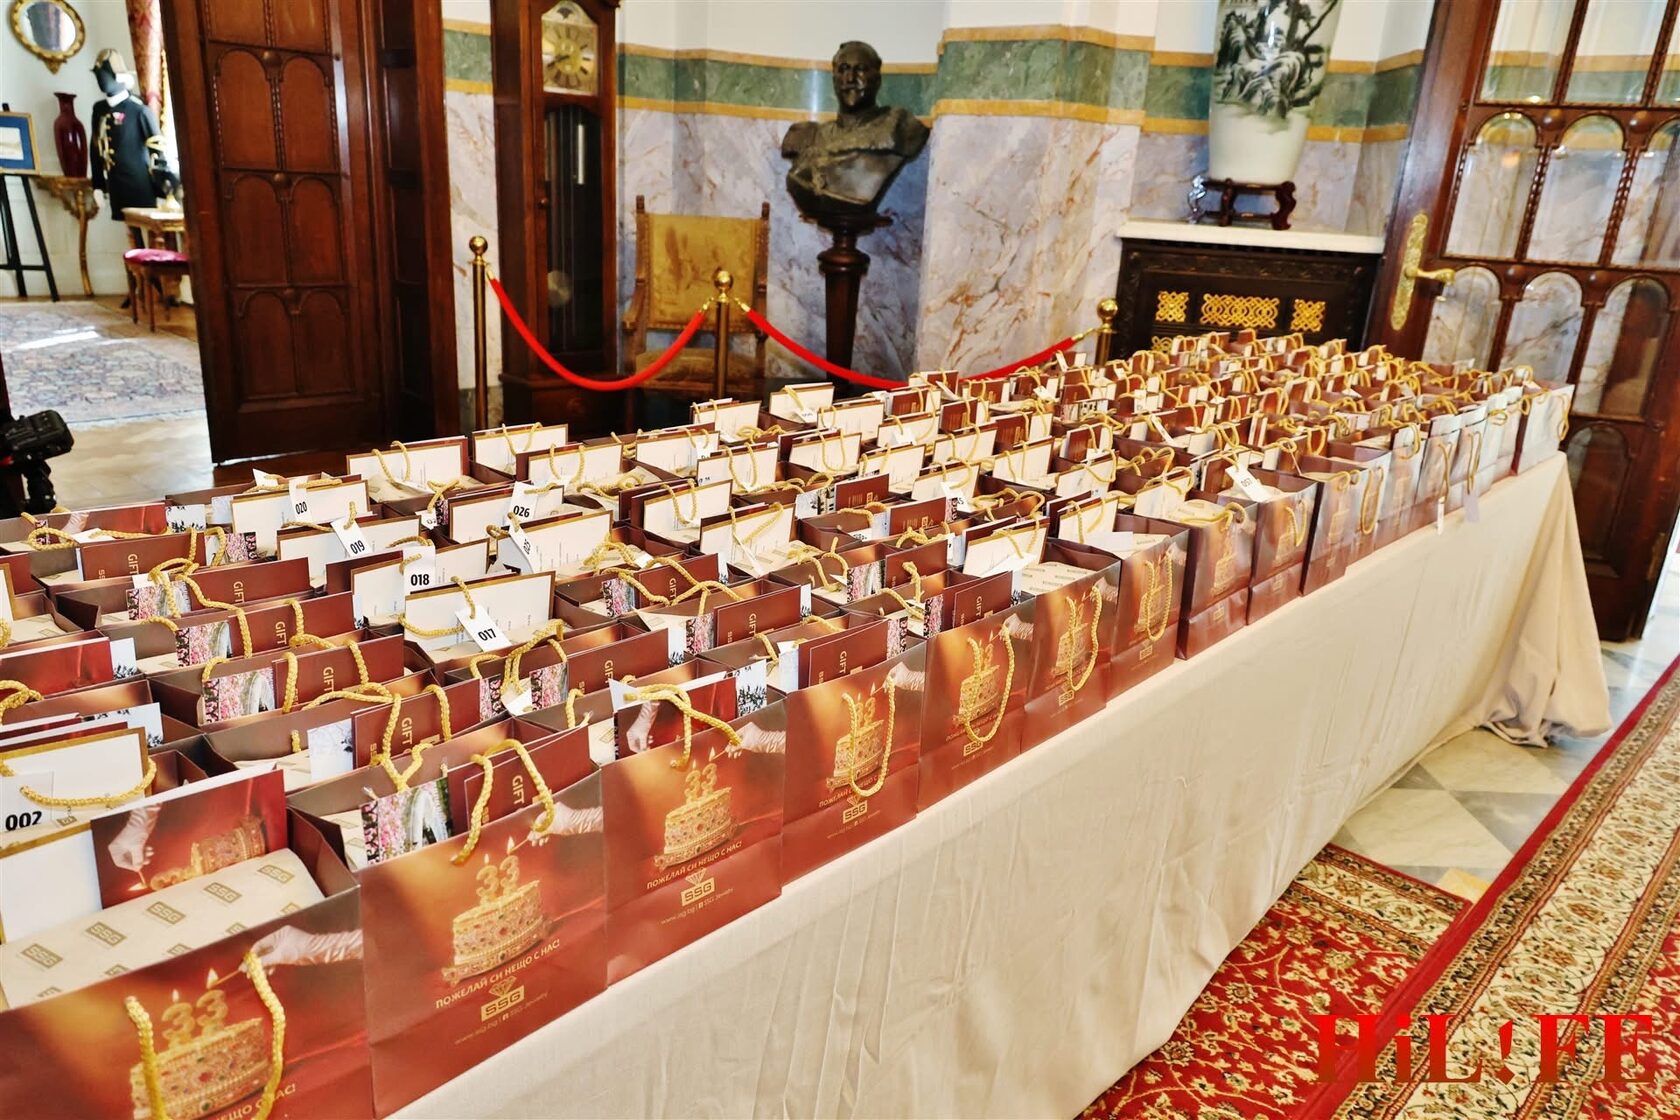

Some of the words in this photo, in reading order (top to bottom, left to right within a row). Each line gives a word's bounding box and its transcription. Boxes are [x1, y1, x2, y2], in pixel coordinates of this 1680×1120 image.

[295, 501, 308, 514] 020
[513, 505, 530, 518] 026
[349, 540, 366, 554] 019
[410, 573, 430, 586] 018
[669, 578, 677, 598] GIFT
[233, 580, 245, 603] GIFT
[275, 621, 287, 645] GIFT
[478, 628, 497, 641] 017
[839, 650, 847, 674] GIFT
[323, 666, 334, 692] GIFT
[401, 716, 413, 745] GIFT
[512, 775, 524, 805] GIFT
[5, 810, 42, 832] 002
[844, 803, 866, 821] SSG
[646, 866, 686, 890] ПОЖЕЛАЙ
[204, 883, 241, 903] SSG
[684, 882, 712, 902] SSG
[147, 902, 185, 924] SSG
[87, 922, 126, 946] SSG
[24, 944, 62, 968] SSG
[436, 977, 488, 1009] ПОЖЕЛАЙ
[489, 972, 503, 984] СИ
[504, 956, 534, 976] НЕЩО
[534, 952, 540, 960] С
[541, 939, 560, 957] НАС!
[484, 989, 522, 1017] SSG
[216, 1103, 252, 1120] ЕЩО
[275, 1084, 296, 1099] АС!
